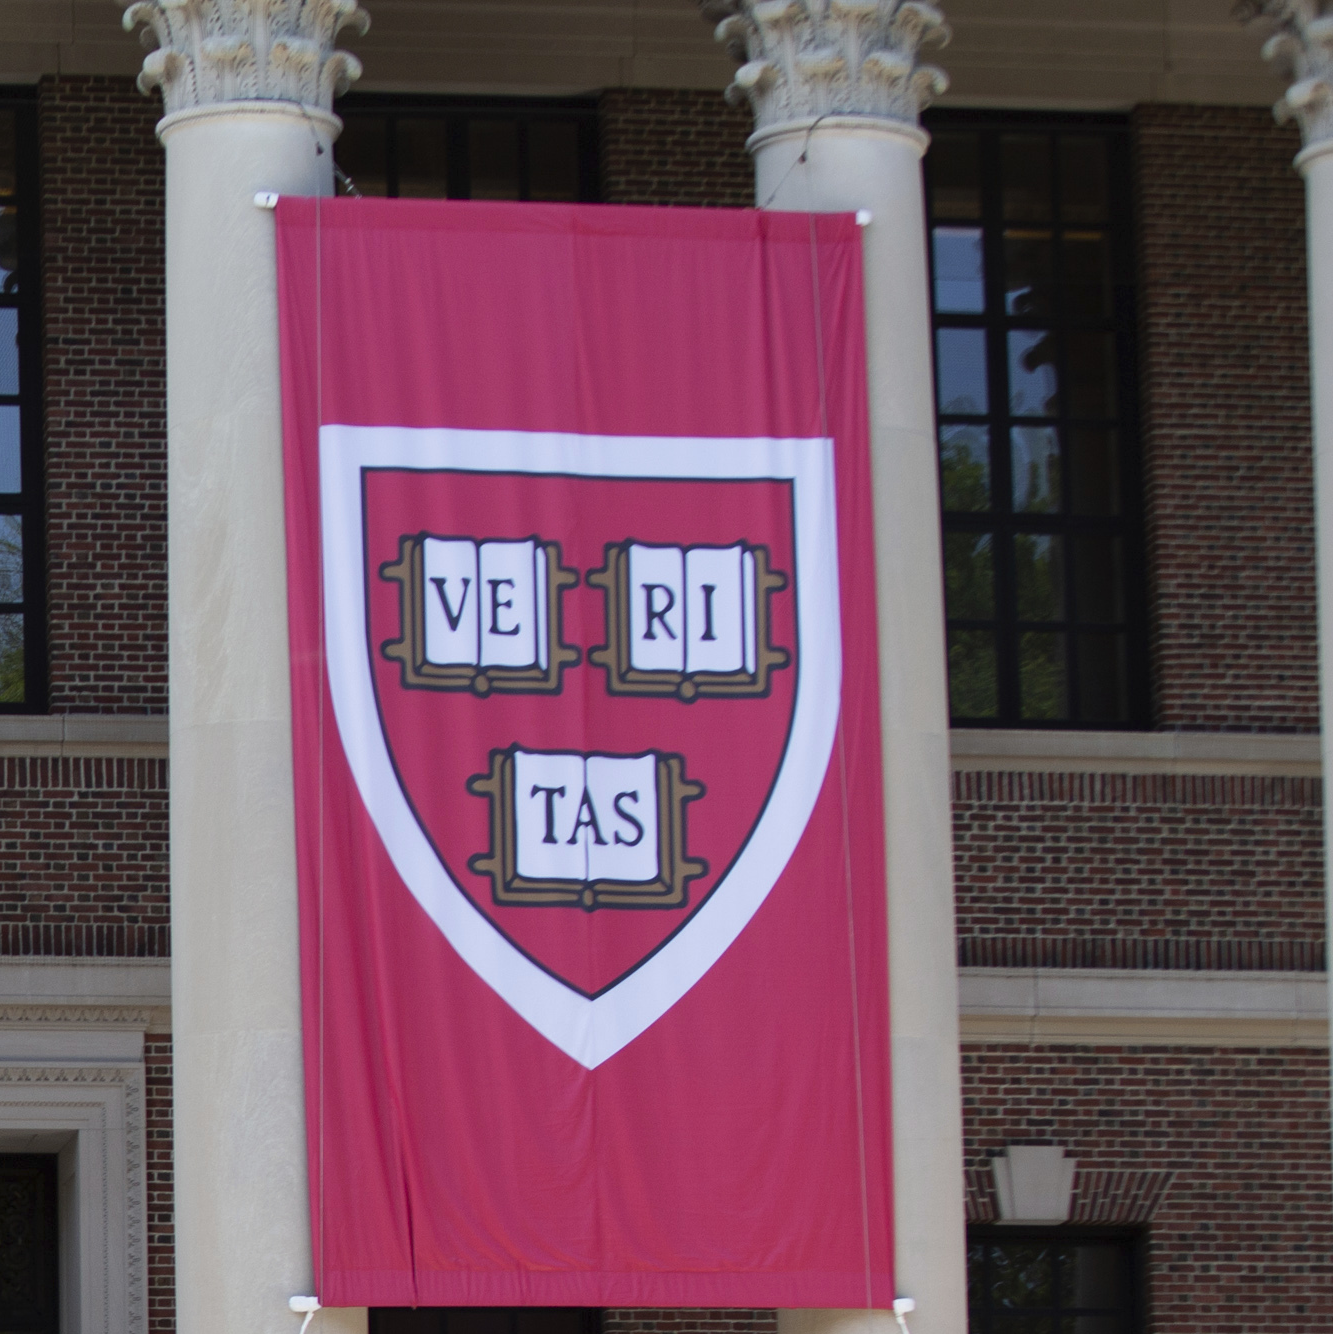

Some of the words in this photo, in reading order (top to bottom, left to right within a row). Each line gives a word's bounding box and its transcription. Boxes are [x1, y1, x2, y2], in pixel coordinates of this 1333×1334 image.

[429, 577, 521, 636] VE
[641, 583, 720, 643] RI
[530, 784, 646, 846] TAS
